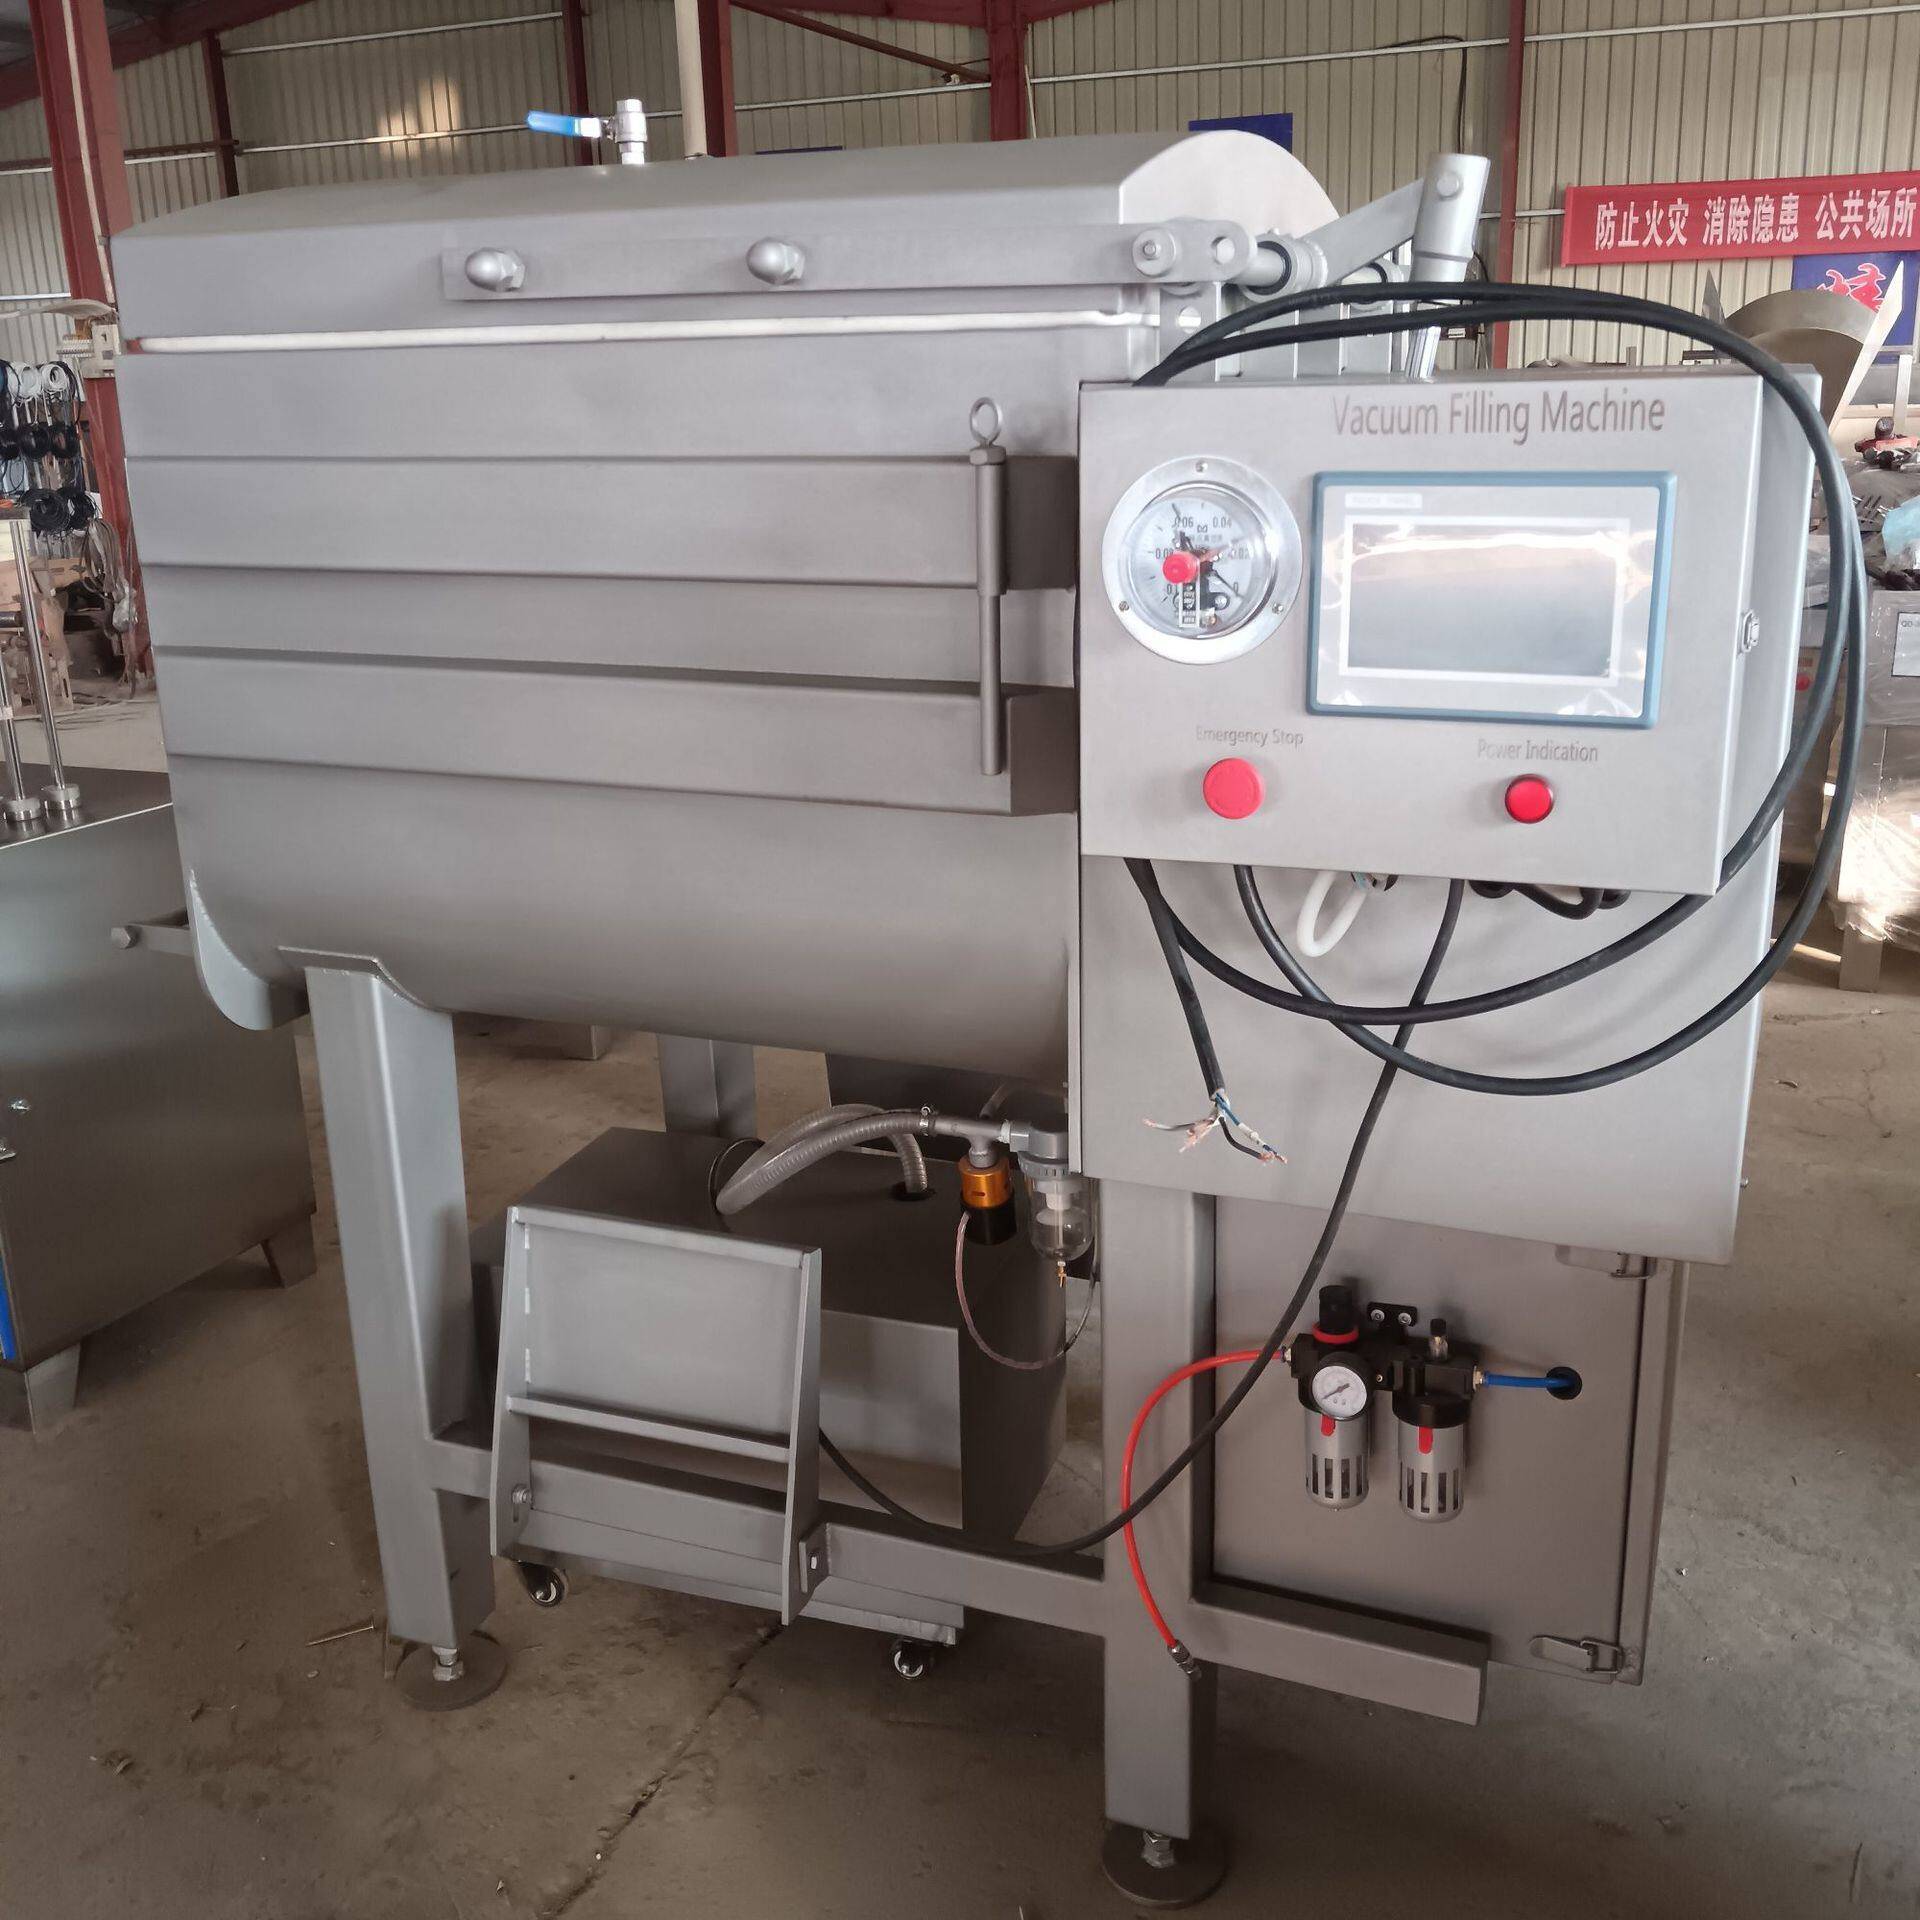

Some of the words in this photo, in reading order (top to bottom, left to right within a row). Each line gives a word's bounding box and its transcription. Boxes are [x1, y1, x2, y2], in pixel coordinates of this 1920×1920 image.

[1595, 197, 1690, 250] 防止火灾
[1702, 192, 1800, 246] 消除隐患
[1815, 186, 1918, 241] 公共场所
[1333, 394, 1438, 435] Vacuum
[1450, 390, 1530, 445] Filling
[1541, 387, 1666, 433] Machine
[1196, 726, 1268, 747] Emergency
[1272, 728, 1304, 749] Stop
[1478, 739, 1521, 759] Power
[1525, 739, 1598, 761] Indication
